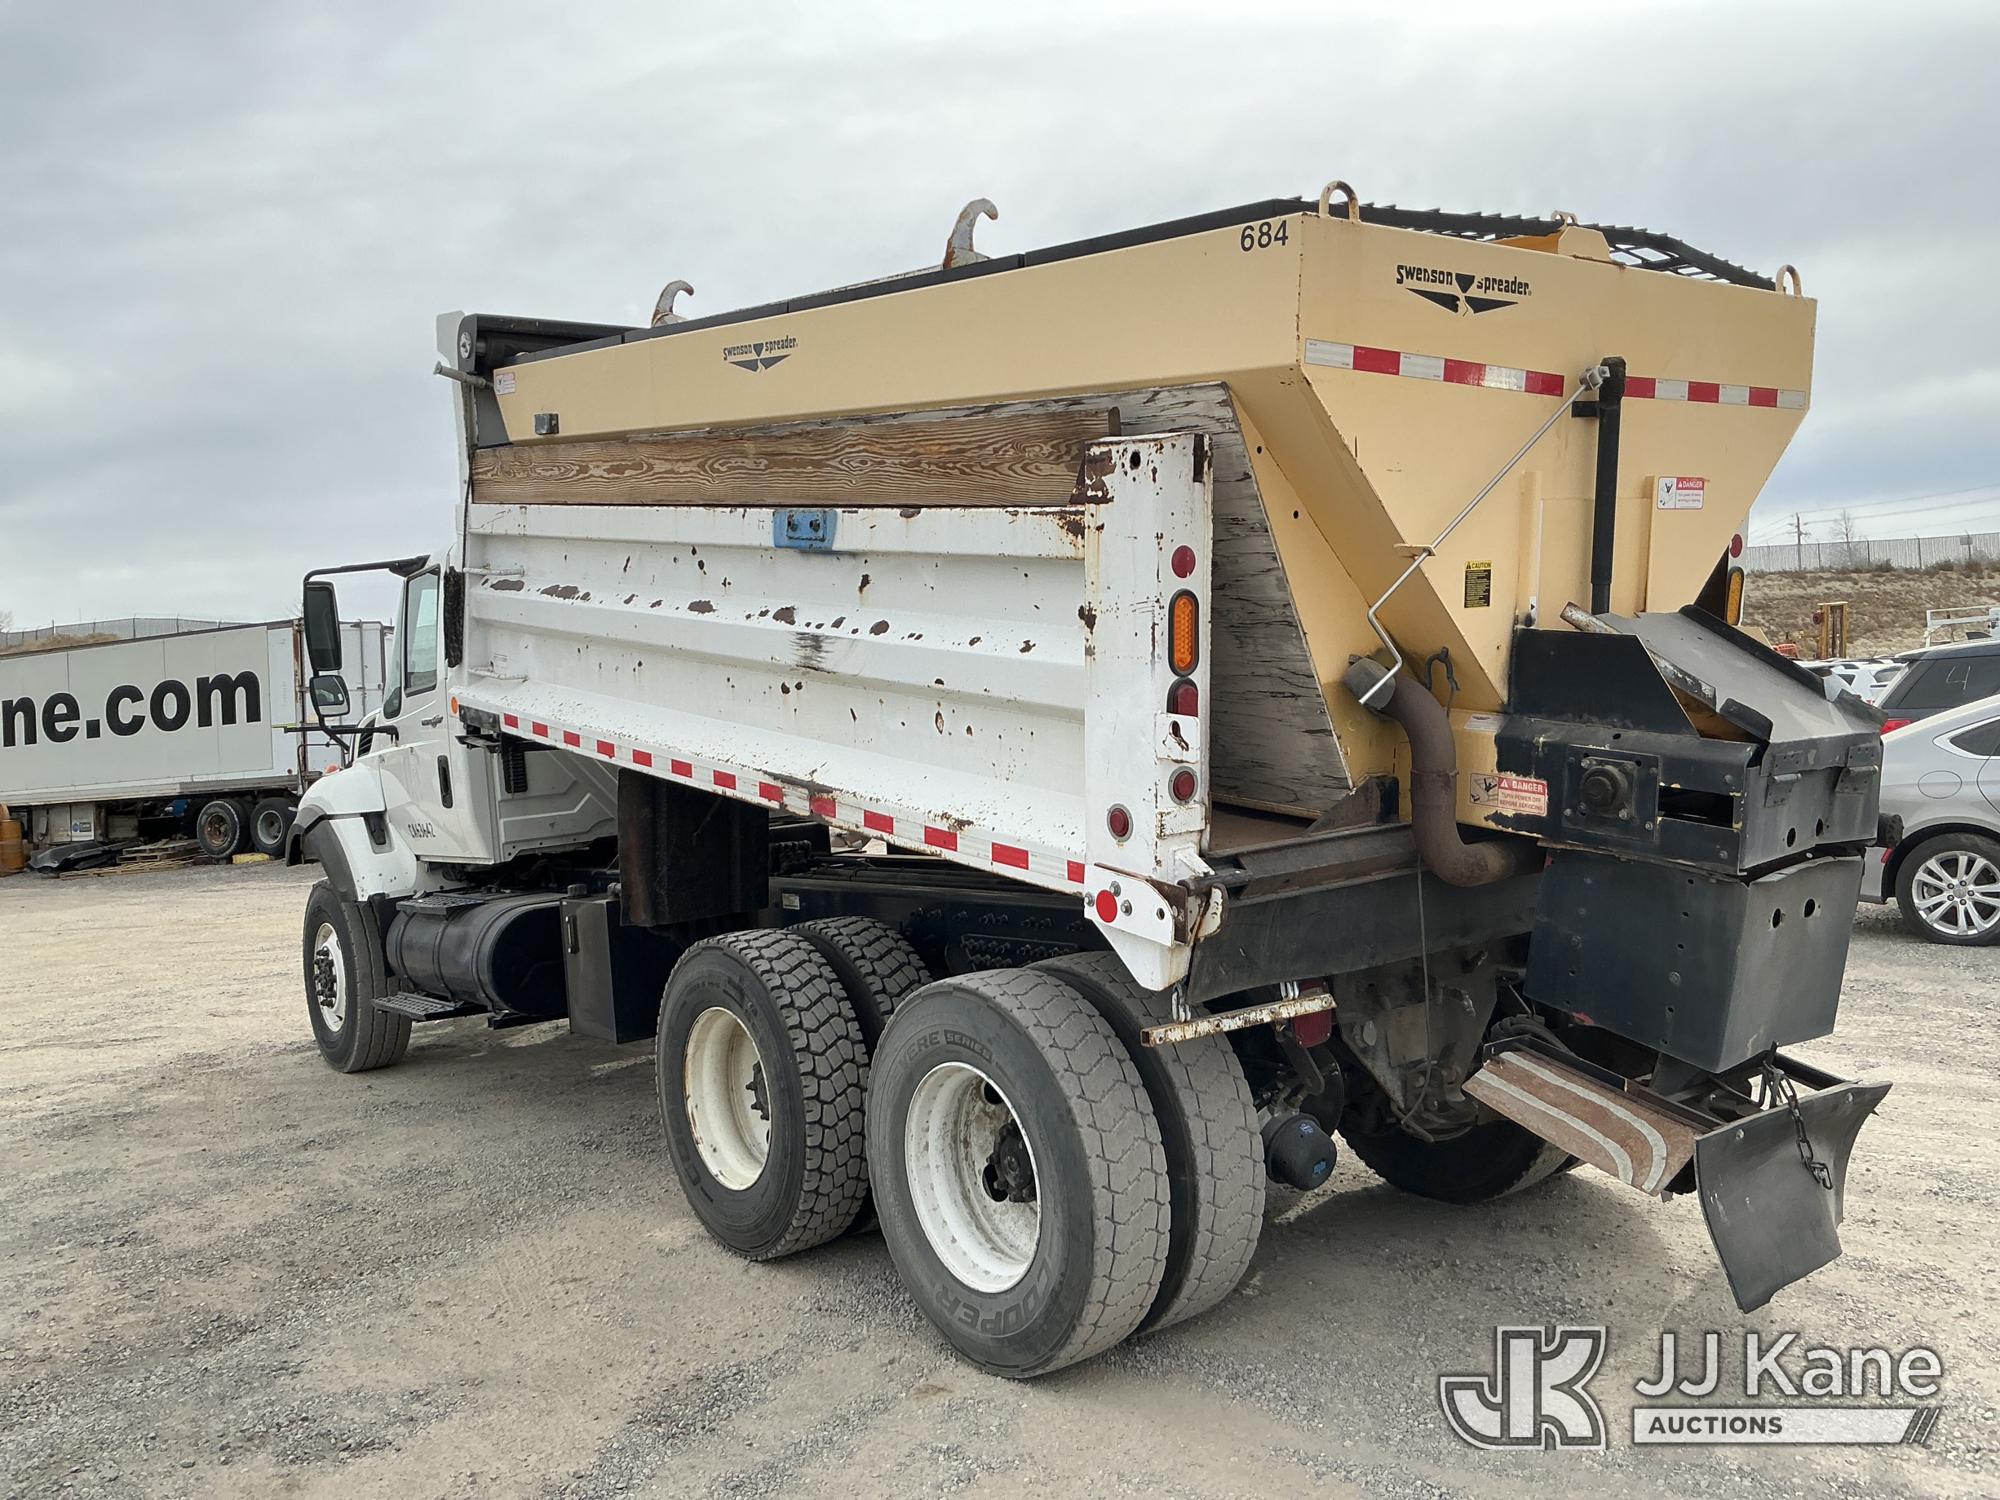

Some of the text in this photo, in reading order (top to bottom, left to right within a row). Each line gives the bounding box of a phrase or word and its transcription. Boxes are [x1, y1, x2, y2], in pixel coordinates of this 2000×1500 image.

[1241, 220, 1288, 252] 684
[1396, 265, 1453, 285] Swenson
[723, 343, 752, 361] Swenson
[1682, 480, 1702, 488] DANGER
[1945, 665, 1971, 690] 4
[1, 670, 261, 748] ne.com
[1511, 780, 1543, 793] DANGER
[935, 1256, 1050, 1333] COOPER
